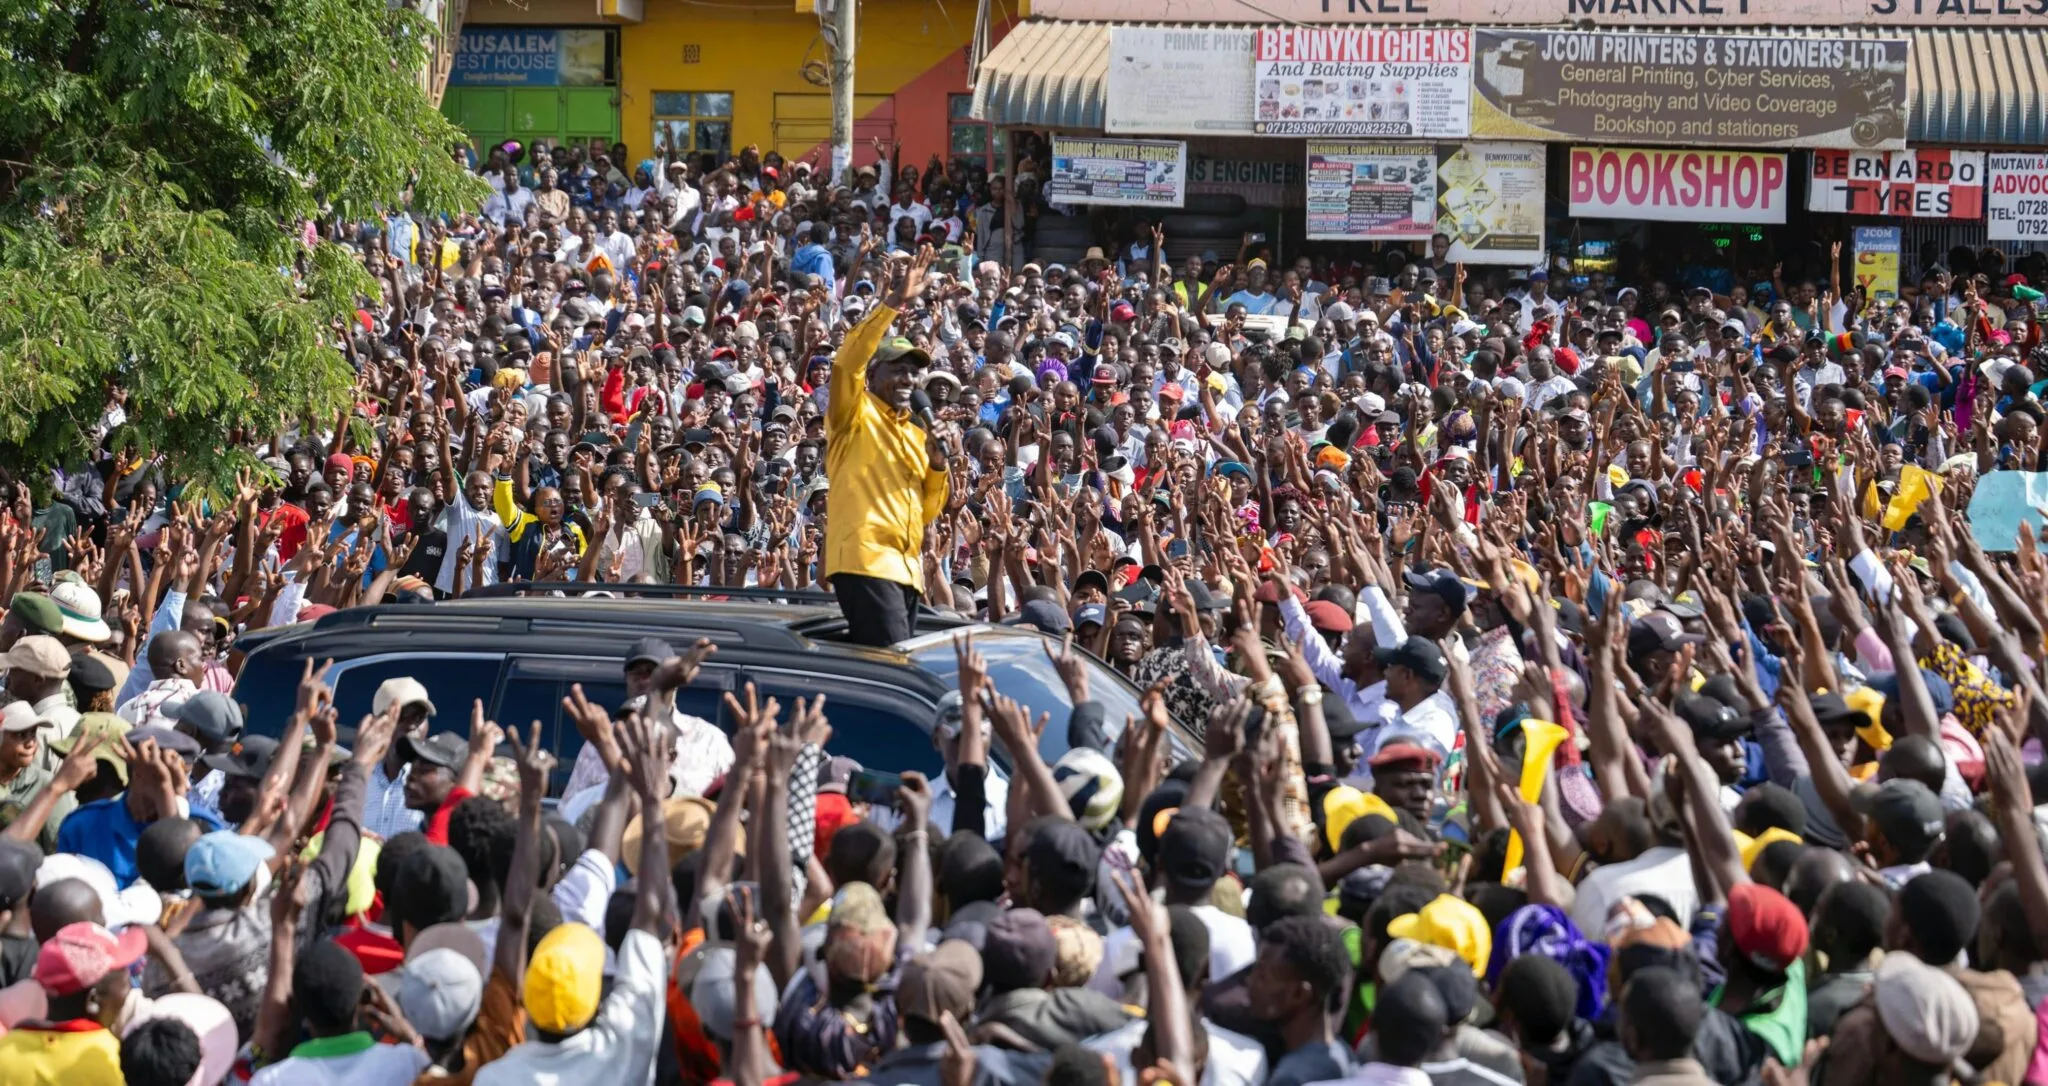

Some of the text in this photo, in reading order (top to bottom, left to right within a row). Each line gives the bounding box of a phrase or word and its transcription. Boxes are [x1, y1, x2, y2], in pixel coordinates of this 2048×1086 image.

[1163, 33, 1209, 51] PRIME
[1261, 30, 1467, 61] BENNYKITCHENS
[1541, 34, 1887, 69] JCOM PRINTERS & STATIONERS LTD
[495, 54, 556, 69] HOUSE
[1267, 62, 1459, 80] And Baking Supplies
[1561, 63, 1835, 91] General Printing, Cyber Services,
[1558, 87, 1837, 118] Photograghy and Video Coverage
[1265, 121, 1408, 134] 0712939077/0790822526
[1594, 114, 1799, 137] Bookshop and stationers
[1055, 141, 1178, 161] GLORIOUS COMPUTER SERVICES
[1310, 145, 1433, 155] GLORIOUS COMPUTER SERVICES
[1813, 156, 1975, 182] BERNARDO
[1990, 157, 2044, 170] MUTAVI &
[1570, 150, 1784, 209] BOOKSHOP
[1833, 186, 1953, 213] TYRES
[1990, 200, 2048, 220] TEL: 0728
[1863, 228, 1893, 238] JCOM
[2017, 219, 2048, 234] 0792
